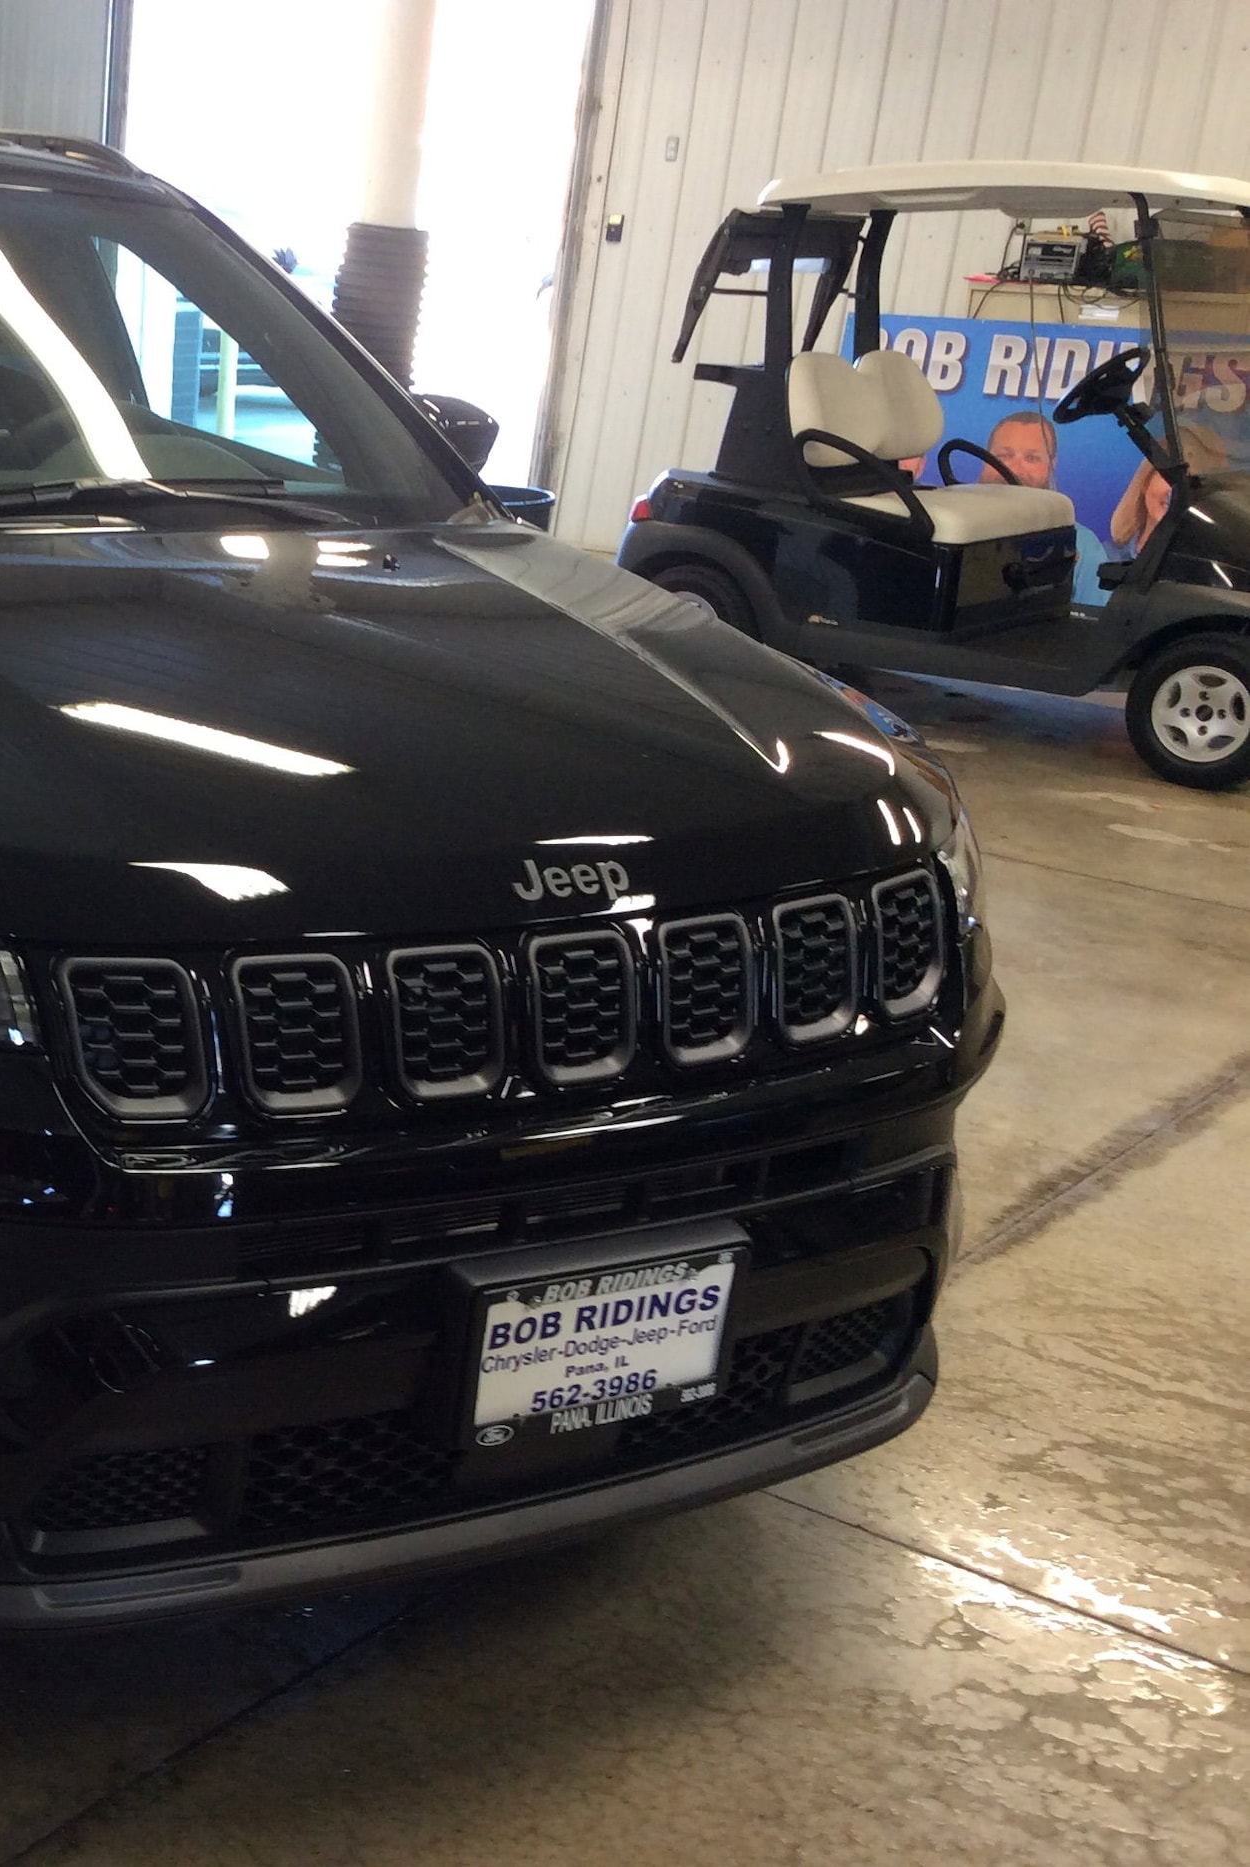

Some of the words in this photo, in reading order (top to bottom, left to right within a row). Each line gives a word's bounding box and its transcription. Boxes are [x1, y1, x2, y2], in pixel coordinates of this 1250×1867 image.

[880, 328, 966, 391] OB
[512, 860, 630, 901] Jeep
[542, 1278, 592, 1304] BOB
[595, 1262, 689, 1295] RIDINGS
[489, 1311, 562, 1350] BOB
[574, 1285, 721, 1333] RIDINGS
[615, 1355, 630, 1368] IL
[531, 1368, 657, 1412] 562-3986
[595, 1393, 653, 1425] ILLINOIS
